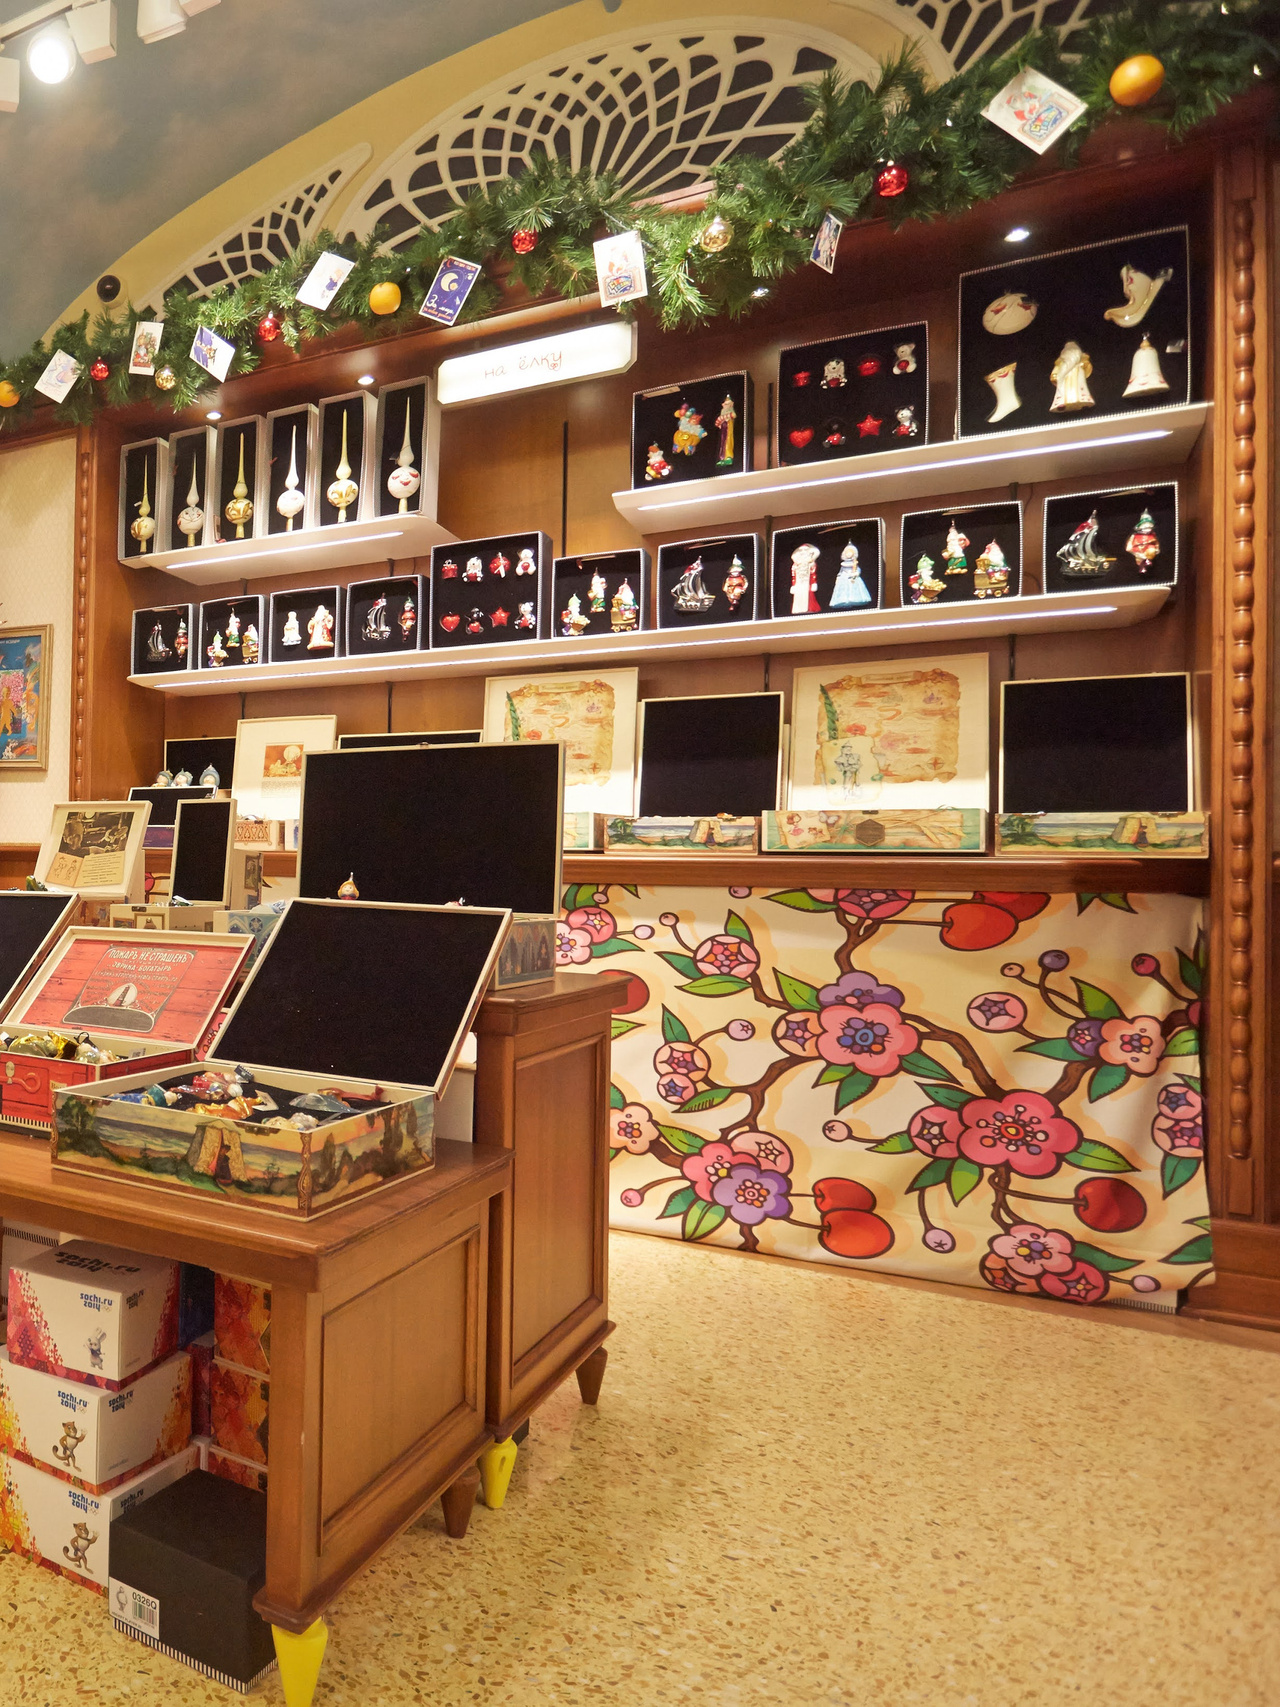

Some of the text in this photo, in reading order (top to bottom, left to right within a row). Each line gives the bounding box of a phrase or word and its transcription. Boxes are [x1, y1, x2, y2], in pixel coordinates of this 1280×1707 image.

[484, 366, 507, 379] на
[108, 949, 138, 960] ПОЖАРЪ
[140, 951, 150, 961] НЕ
[54, 1251, 141, 1272] sochi.ru
[80, 1292, 113, 1306] sochi.ru
[57, 1390, 88, 1407] sochi.ru
[108, 1390, 134, 1407] sochi.ru
[68, 1490, 100, 1509] sochi.ru
